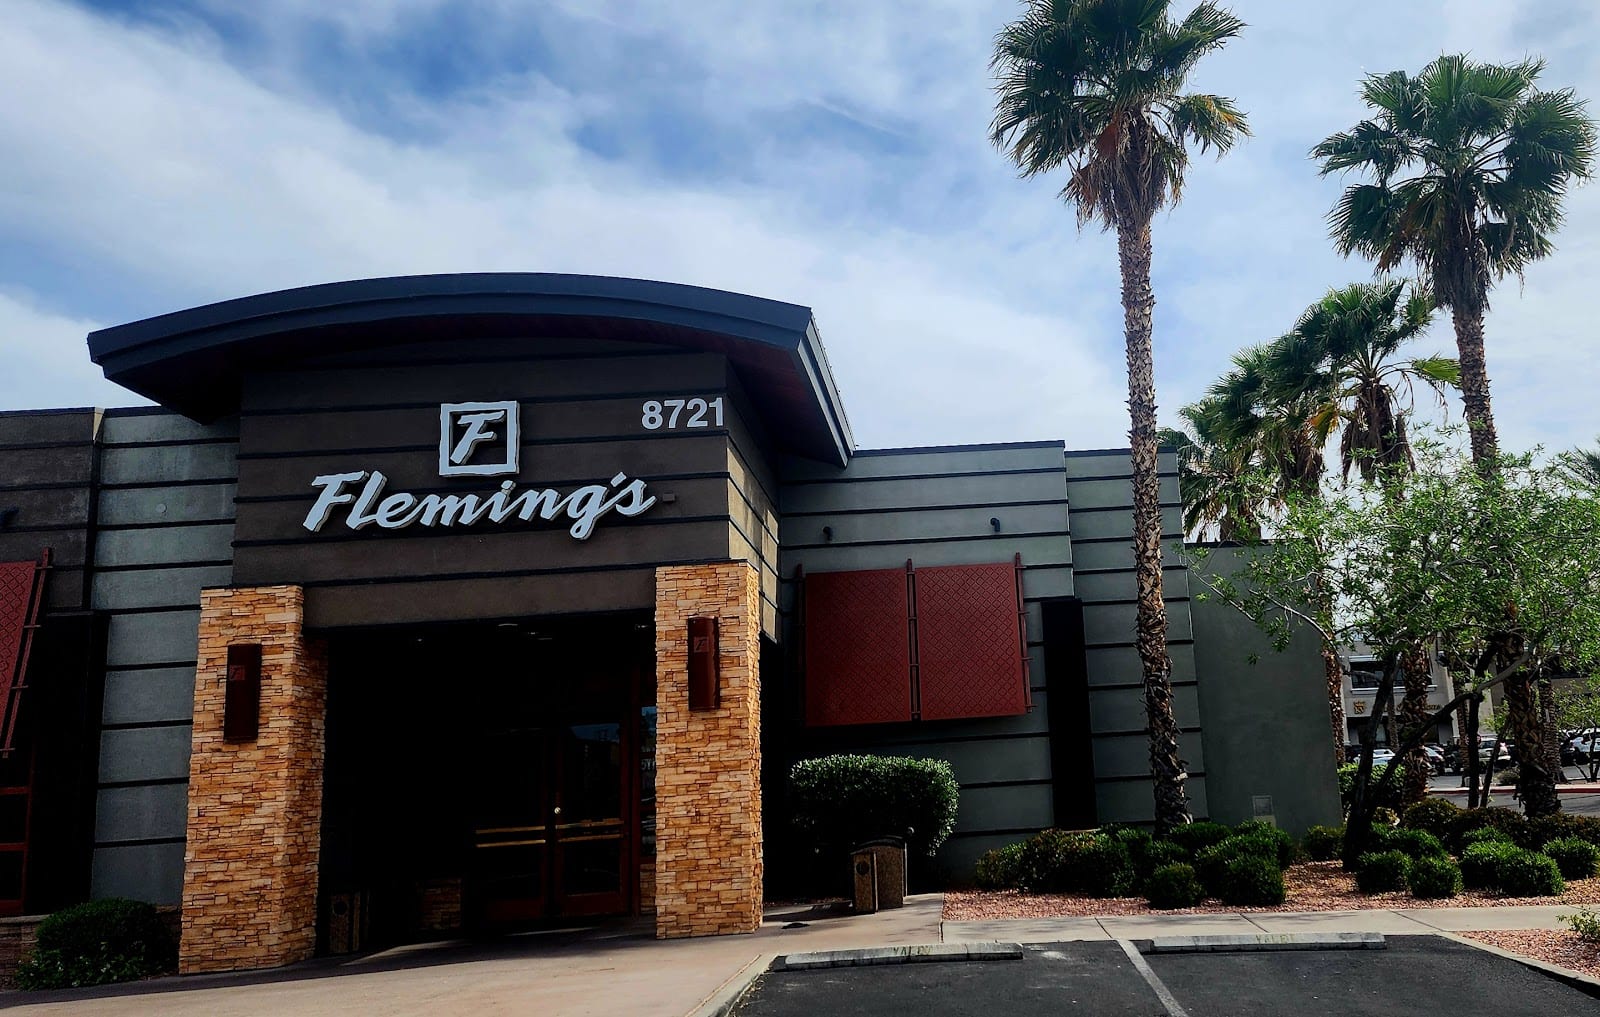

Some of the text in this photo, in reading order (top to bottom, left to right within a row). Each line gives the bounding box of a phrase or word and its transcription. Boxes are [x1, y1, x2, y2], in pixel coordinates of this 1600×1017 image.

[450, 410, 505, 464] F
[641, 397, 724, 430] 8721
[302, 470, 656, 540] Fleming's
